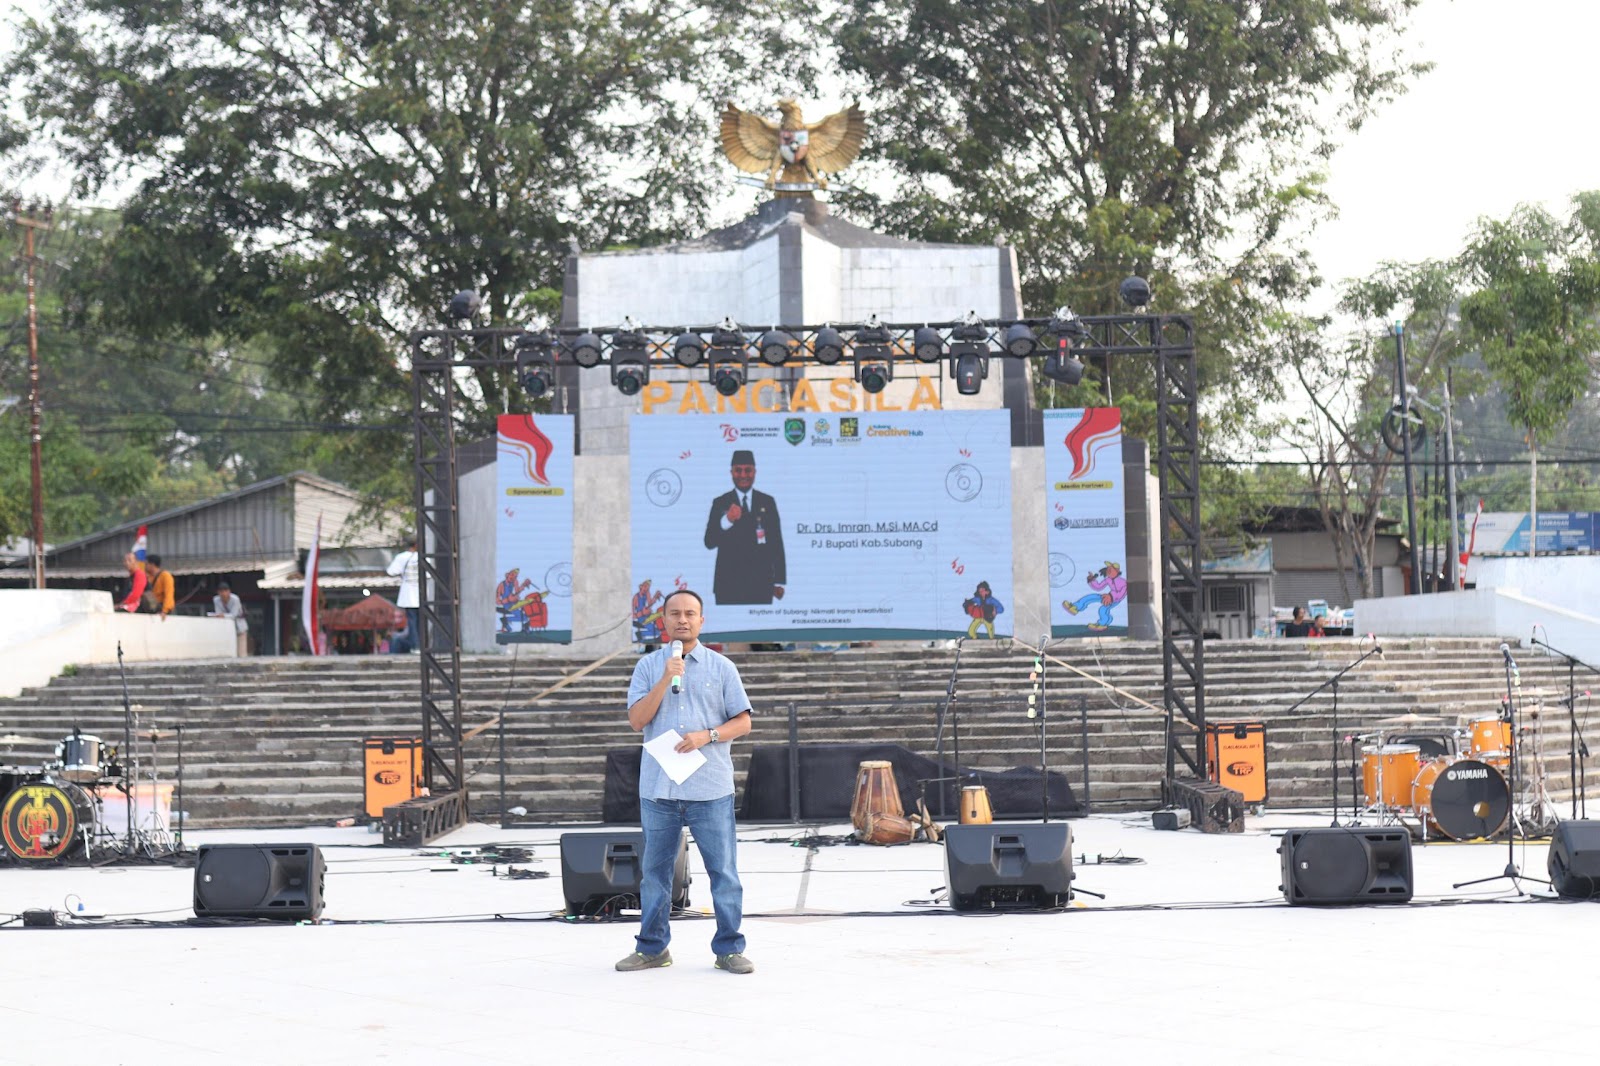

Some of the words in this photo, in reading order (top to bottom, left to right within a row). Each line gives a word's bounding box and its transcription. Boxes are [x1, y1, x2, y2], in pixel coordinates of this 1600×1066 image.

[641, 375, 941, 413] PANCASILA
[797, 523, 812, 533] Dr.
[815, 523, 836, 533] Drs.
[811, 540, 823, 549] PJ
[825, 539, 859, 550] Bupati
[1456, 769, 1488, 779] YAMAHA
